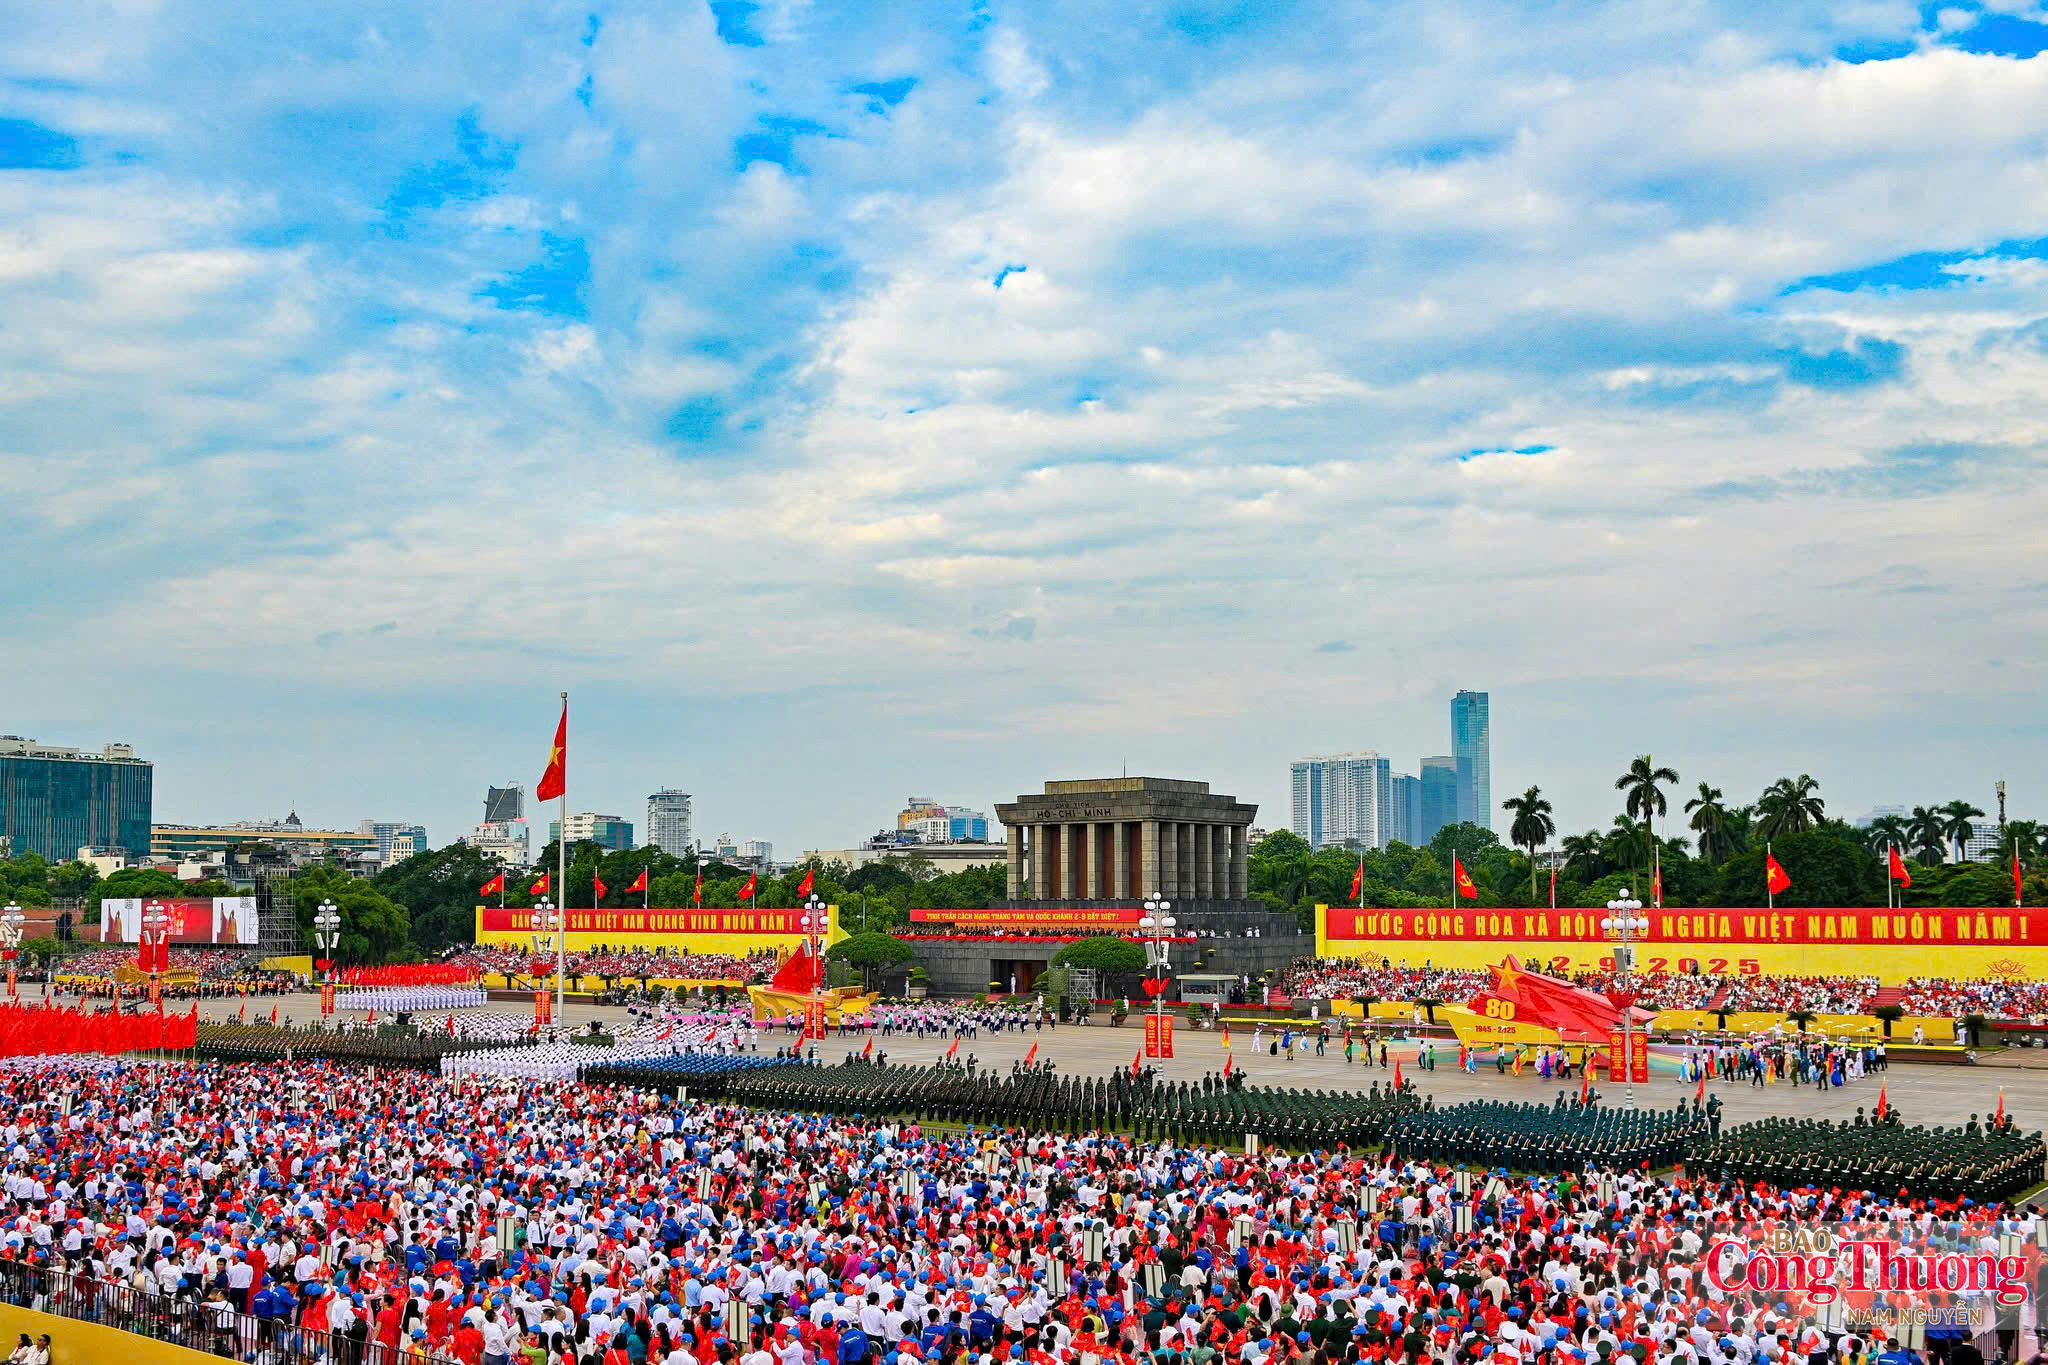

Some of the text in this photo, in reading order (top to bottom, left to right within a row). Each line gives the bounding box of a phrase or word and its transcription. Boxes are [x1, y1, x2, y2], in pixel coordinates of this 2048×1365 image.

[572, 911, 590, 929] SẢN
[595, 911, 617, 931] VIỆT
[623, 914, 644, 929] NAM
[650, 914, 685, 931] QUANG
[690, 914, 717, 930] VINH
[723, 911, 754, 931] MUÔN
[760, 912, 785, 931] NĂM
[1354, 911, 1402, 936] NƯỚC
[1414, 911, 1464, 939] CỘNG
[1475, 911, 1513, 936] HÒA
[1524, 911, 1549, 937] XÃ
[1560, 911, 1595, 940] HỘI
[1662, 912, 1731, 938] NGHĨA
[1743, 911, 1795, 942] VIỆT
[1808, 915, 1857, 938] NAM
[1872, 912, 1942, 939] MUÔN
[1957, 912, 2011, 939] NĂM
[1486, 998, 1516, 1020] 80
